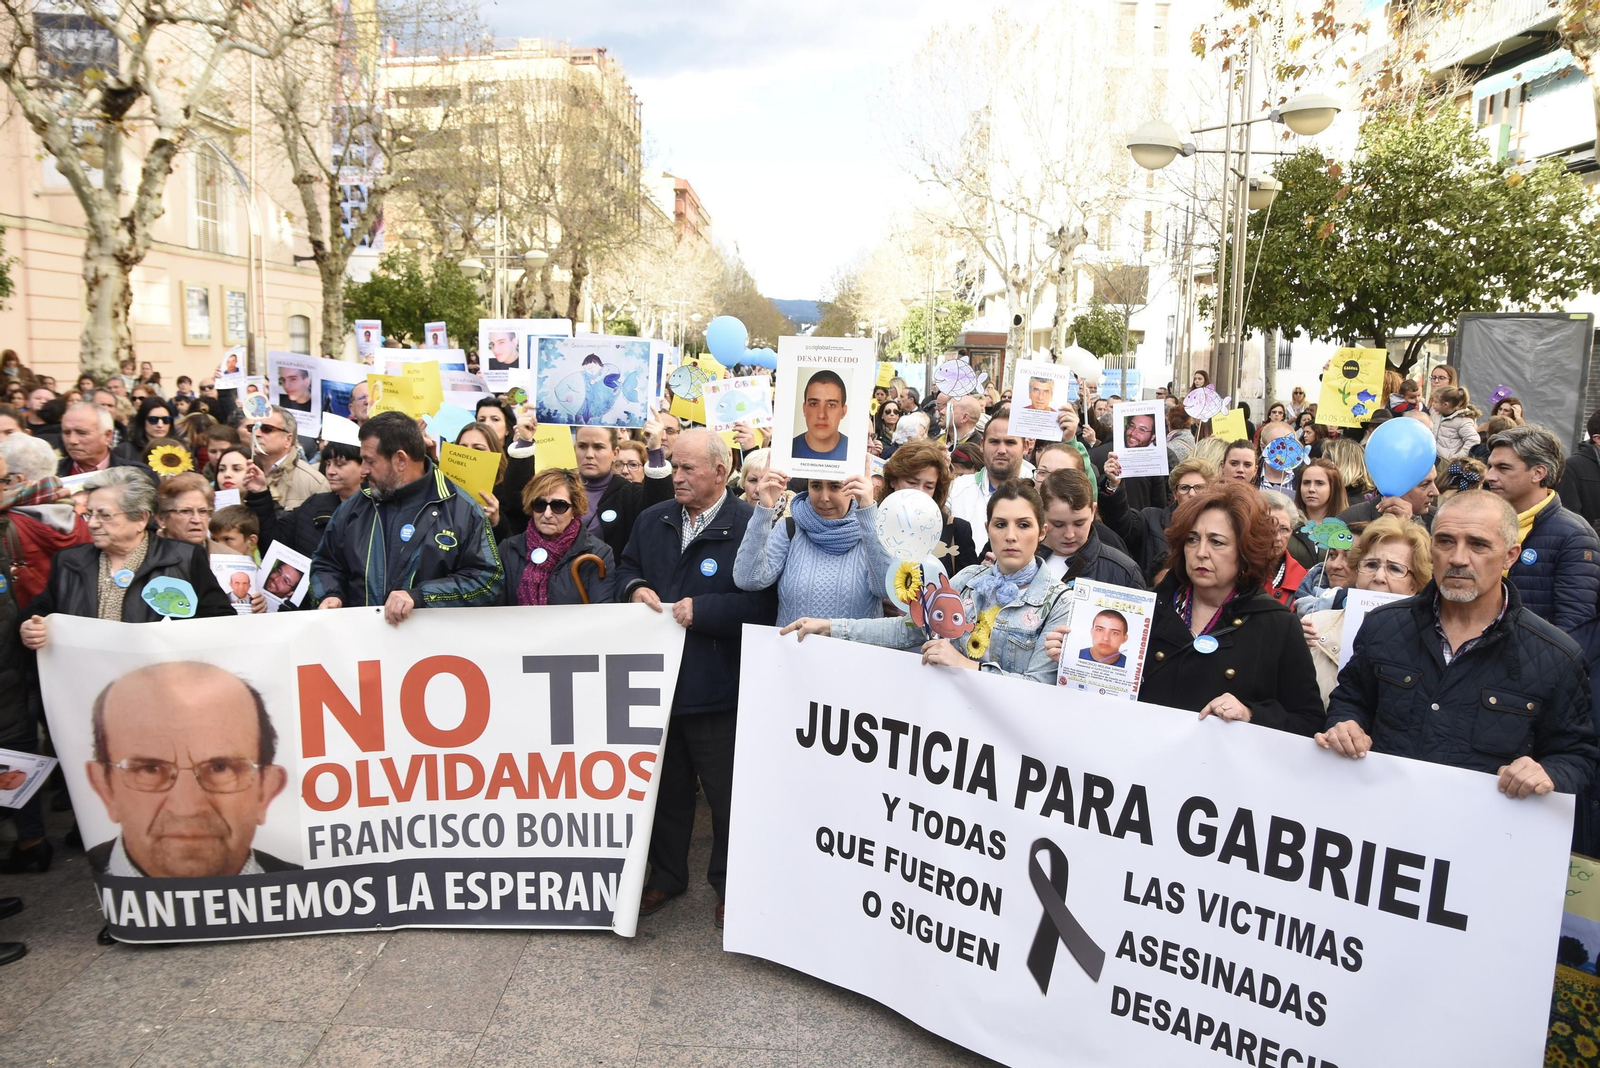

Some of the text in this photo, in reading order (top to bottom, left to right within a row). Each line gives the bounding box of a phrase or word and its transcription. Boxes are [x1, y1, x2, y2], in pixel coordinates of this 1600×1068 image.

[275, 360, 316, 370] DESAPARECIDO
[797, 355, 859, 364] DESAPARECIDO
[1020, 368, 1066, 380] DESAPARECIDO
[449, 450, 477, 461] CANDELA
[450, 474, 466, 484] AÑOS
[1095, 597, 1144, 615] ALERTA
[1138, 617, 1151, 660] PRIORIDAD
[297, 654, 665, 758] NO TE
[302, 749, 657, 812] OLVIDAMOS
[309, 813, 505, 861] FRANCISCO
[796, 701, 1469, 932] JUSTICIA PARA GABRIEL
[882, 793, 1007, 861] Y TODAS
[96, 870, 620, 928] MANTENEMOS LA ESPERAN
[815, 827, 1003, 917] QUE FUERON
[863, 891, 1001, 972] O SIGUEN
[1124, 871, 1364, 973] LAS VICTIMAS
[1115, 930, 1328, 1027] ASESINADAS
